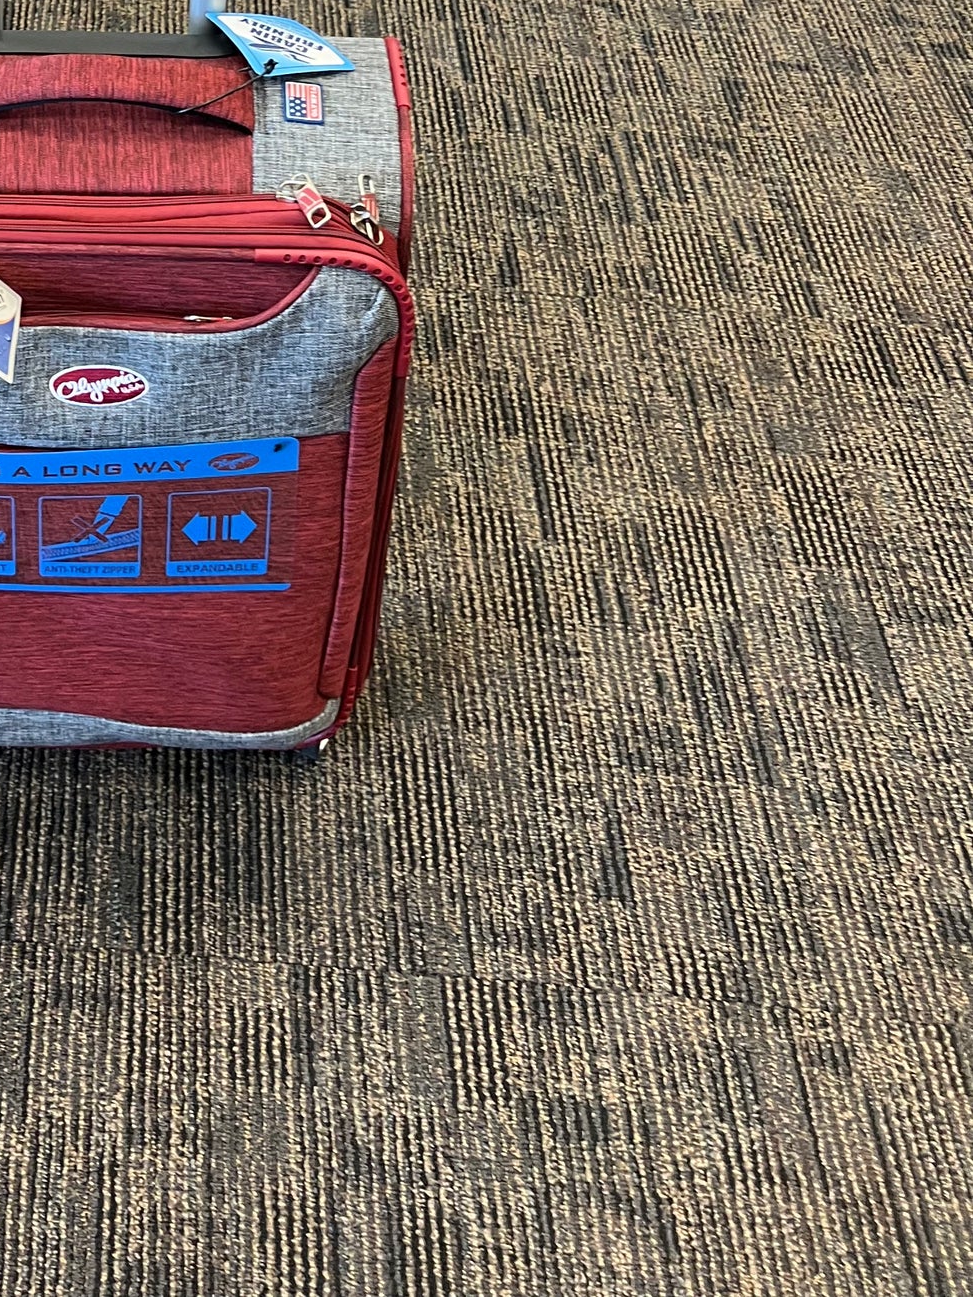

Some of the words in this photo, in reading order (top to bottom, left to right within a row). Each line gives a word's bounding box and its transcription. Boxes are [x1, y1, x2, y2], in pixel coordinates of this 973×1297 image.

[239, 18, 323, 51] FRIENDLY
[250, 27, 308, 53] CABIN
[56, 370, 140, 401] Olympia
[12, 466, 31, 477] A
[43, 463, 122, 478] LONG
[134, 460, 192, 474] WAY
[44, 566, 101, 574] ANTI-THEFT
[103, 566, 136, 574] ZIPPER
[177, 563, 258, 573] EXPANDABLE
